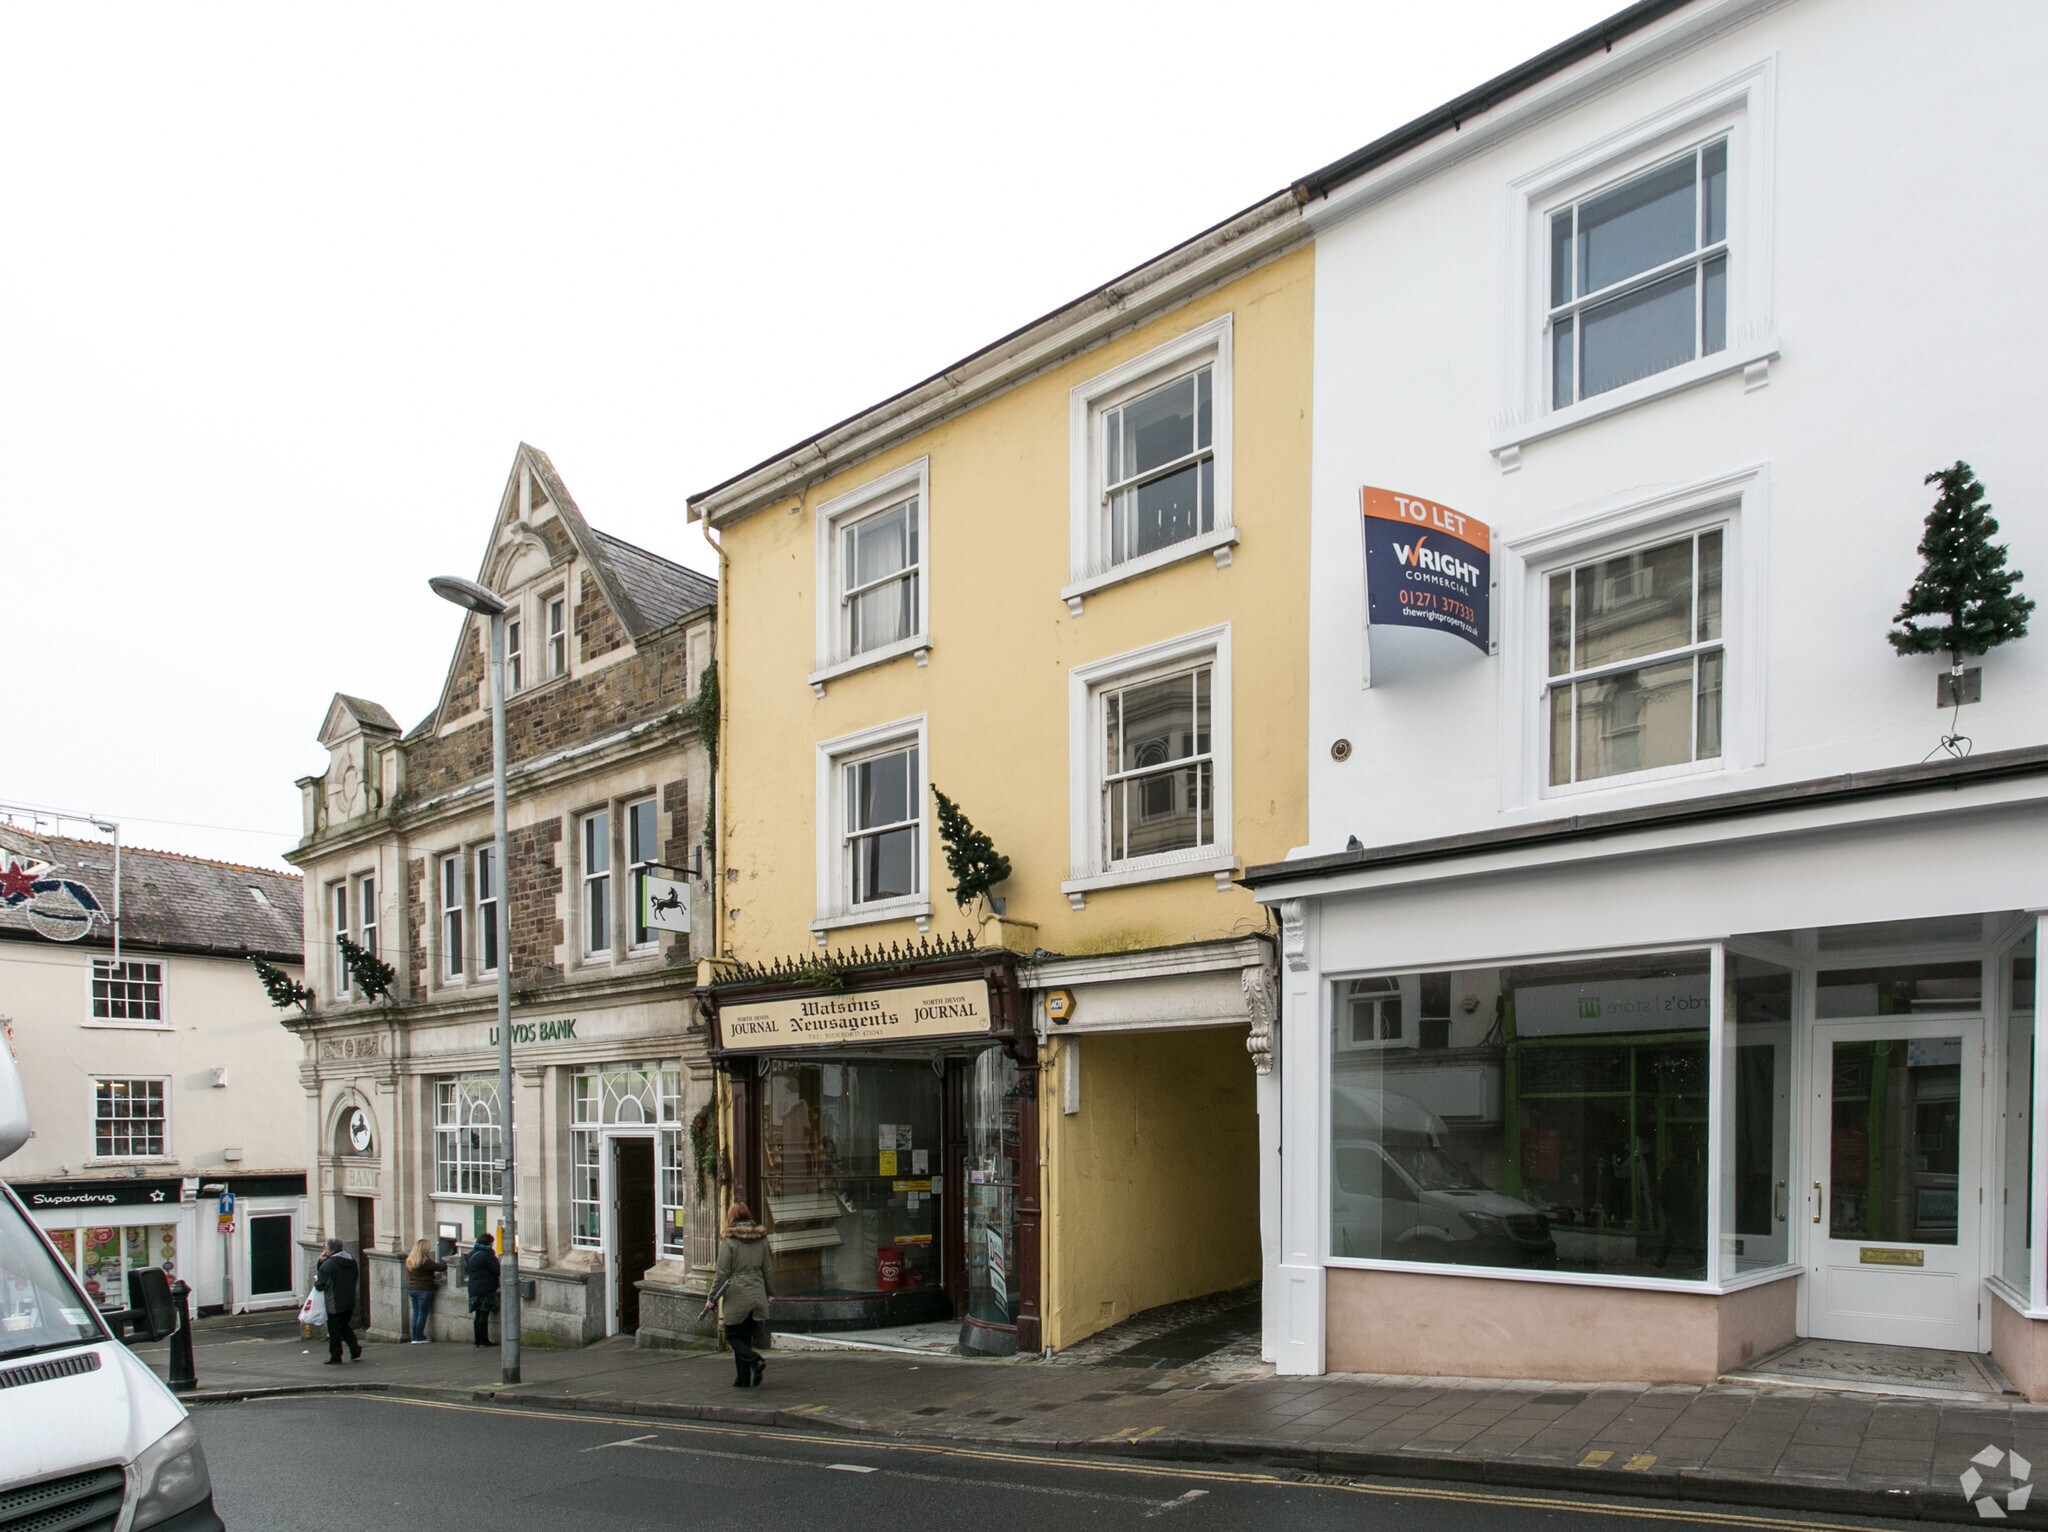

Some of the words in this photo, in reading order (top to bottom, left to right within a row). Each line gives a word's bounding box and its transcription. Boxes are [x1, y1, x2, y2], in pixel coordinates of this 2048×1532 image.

[1393, 496, 1427, 521] TO
[1432, 506, 1466, 535] LET
[1392, 536, 1480, 587] WRIGHT
[1405, 570, 1469, 596] COMMERCIAL
[1399, 589, 1437, 608] 01271
[1442, 597, 1475, 622] 377333
[1402, 607, 1479, 637] thewrightproperty.co.uk
[801, 999, 881, 1016] Watsons
[922, 998, 943, 1006] NORTH
[944, 996, 966, 1004] DEVON
[1050, 999, 1063, 1009] ADT
[789, 1011, 899, 1032] Newsagents
[914, 1003, 978, 1023] JOURNAL
[489, 1022, 536, 1046] LLYDS
[539, 1018, 577, 1041] BANK
[731, 1021, 779, 1037] JOURNAL
[33, 1193, 117, 1205] Superdrug
